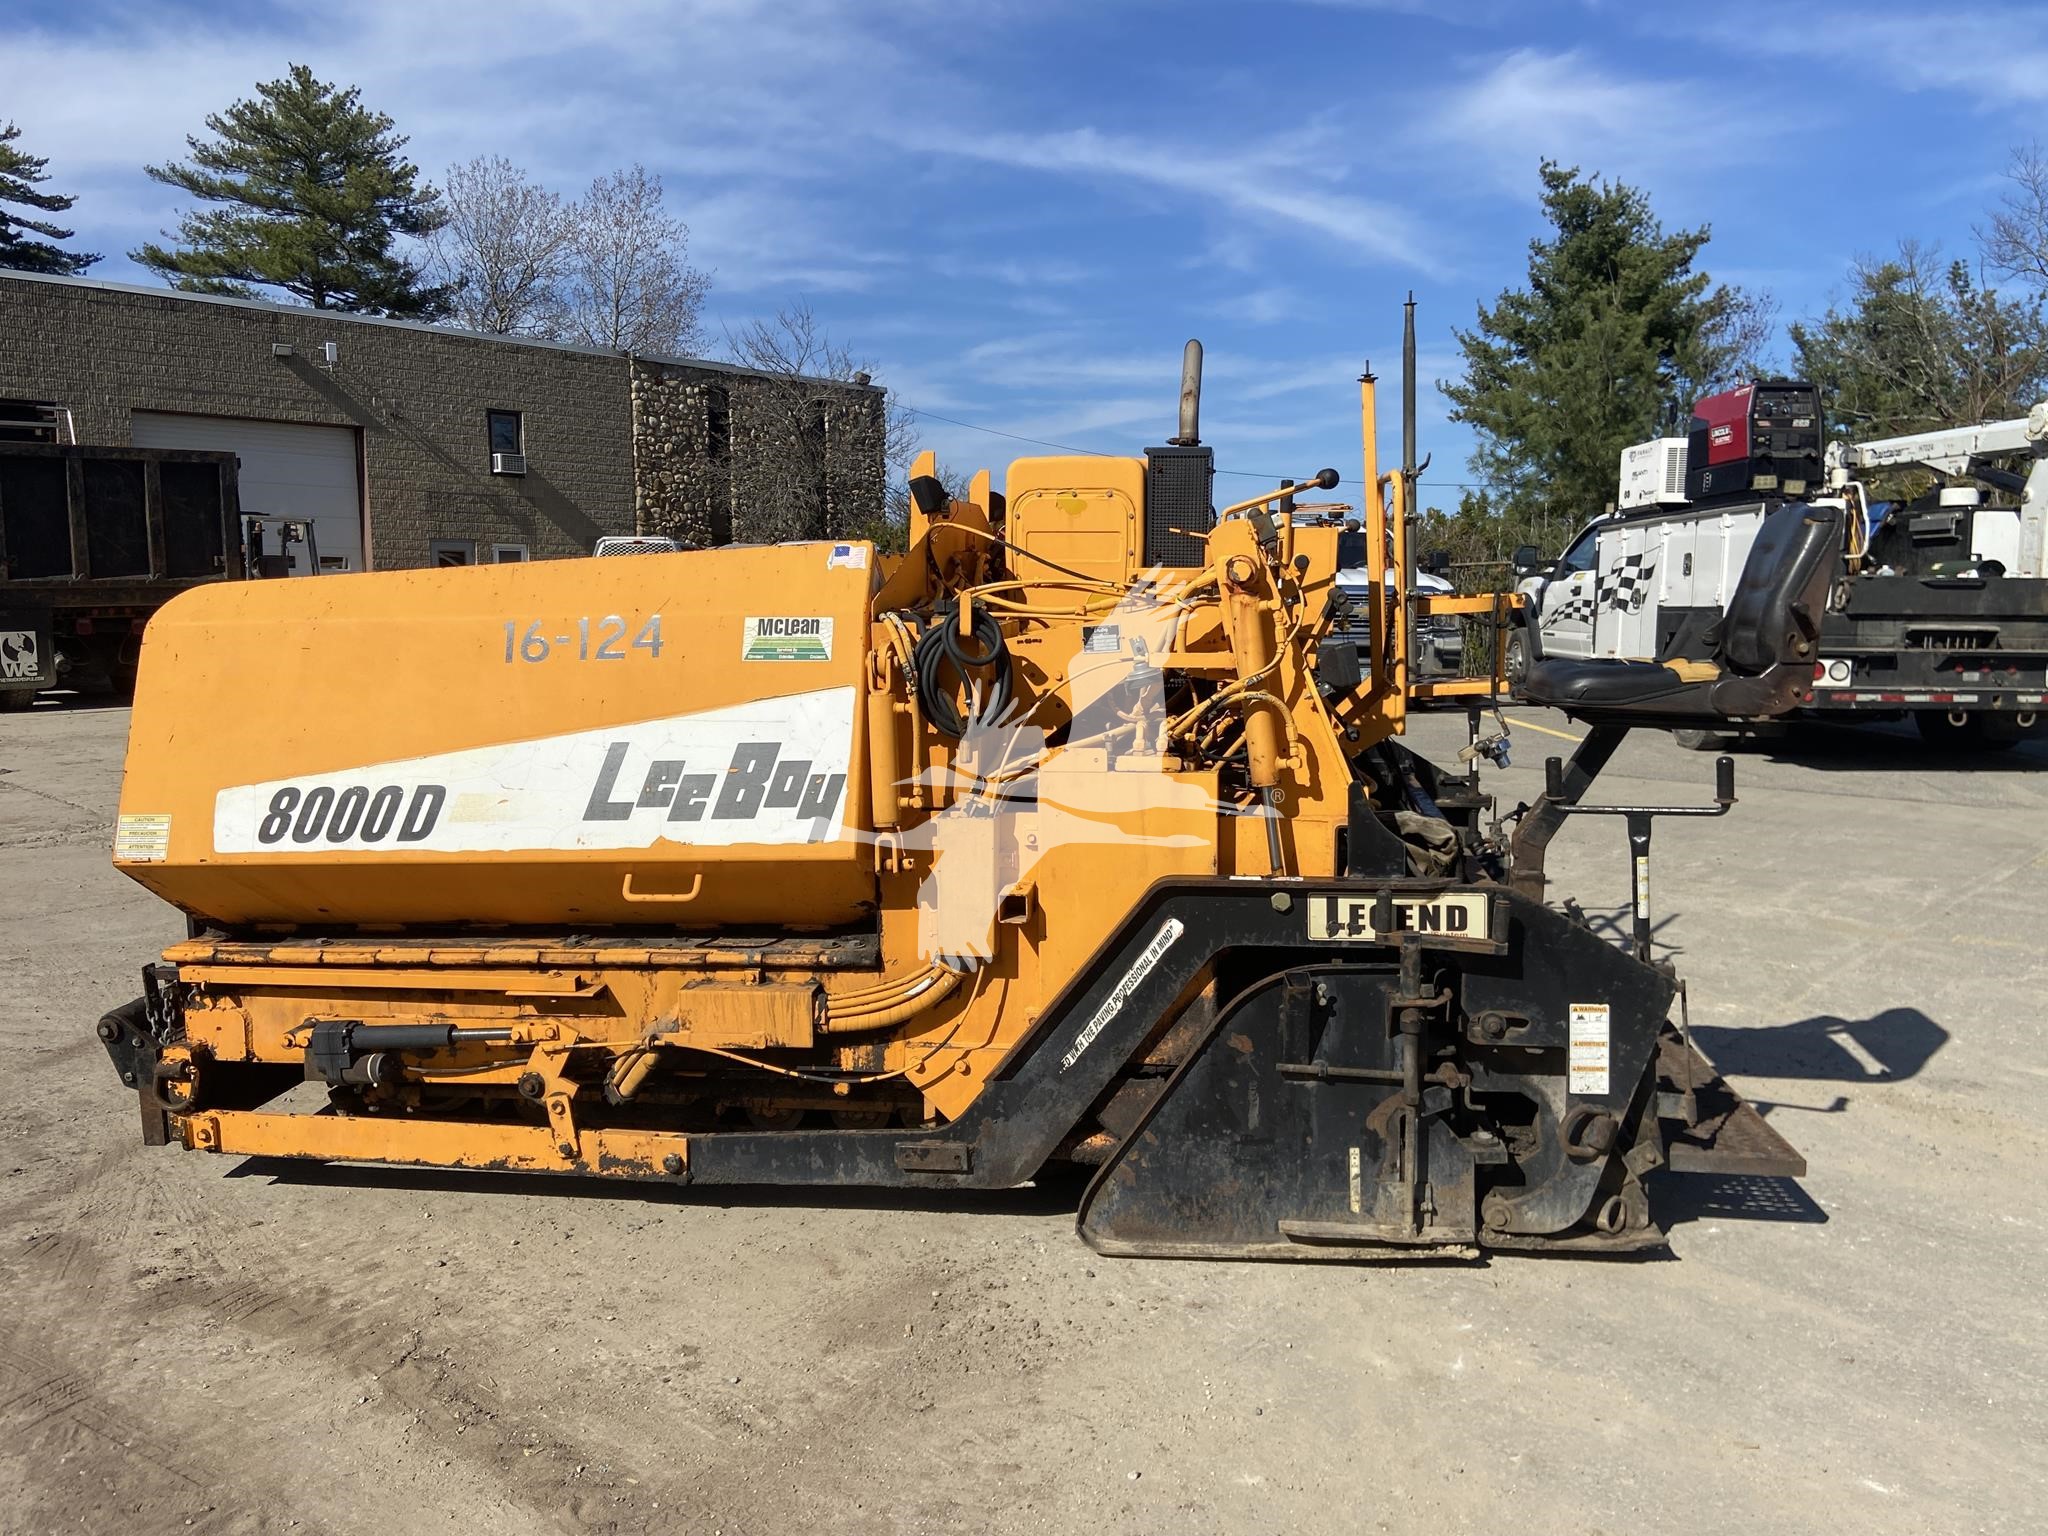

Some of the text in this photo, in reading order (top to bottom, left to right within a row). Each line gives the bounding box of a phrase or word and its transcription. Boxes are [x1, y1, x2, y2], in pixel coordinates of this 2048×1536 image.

[504, 614, 664, 663] 16-124
[757, 618, 820, 636] McLean
[258, 785, 447, 844] 8000D
[582, 742, 847, 843] LeeBoy
[1082, 1026, 1096, 1042] THE
[1093, 1002, 1115, 1031] PAVING
[1112, 956, 1153, 1009] PROFESSIONAL
[1150, 946, 1160, 961] IN
